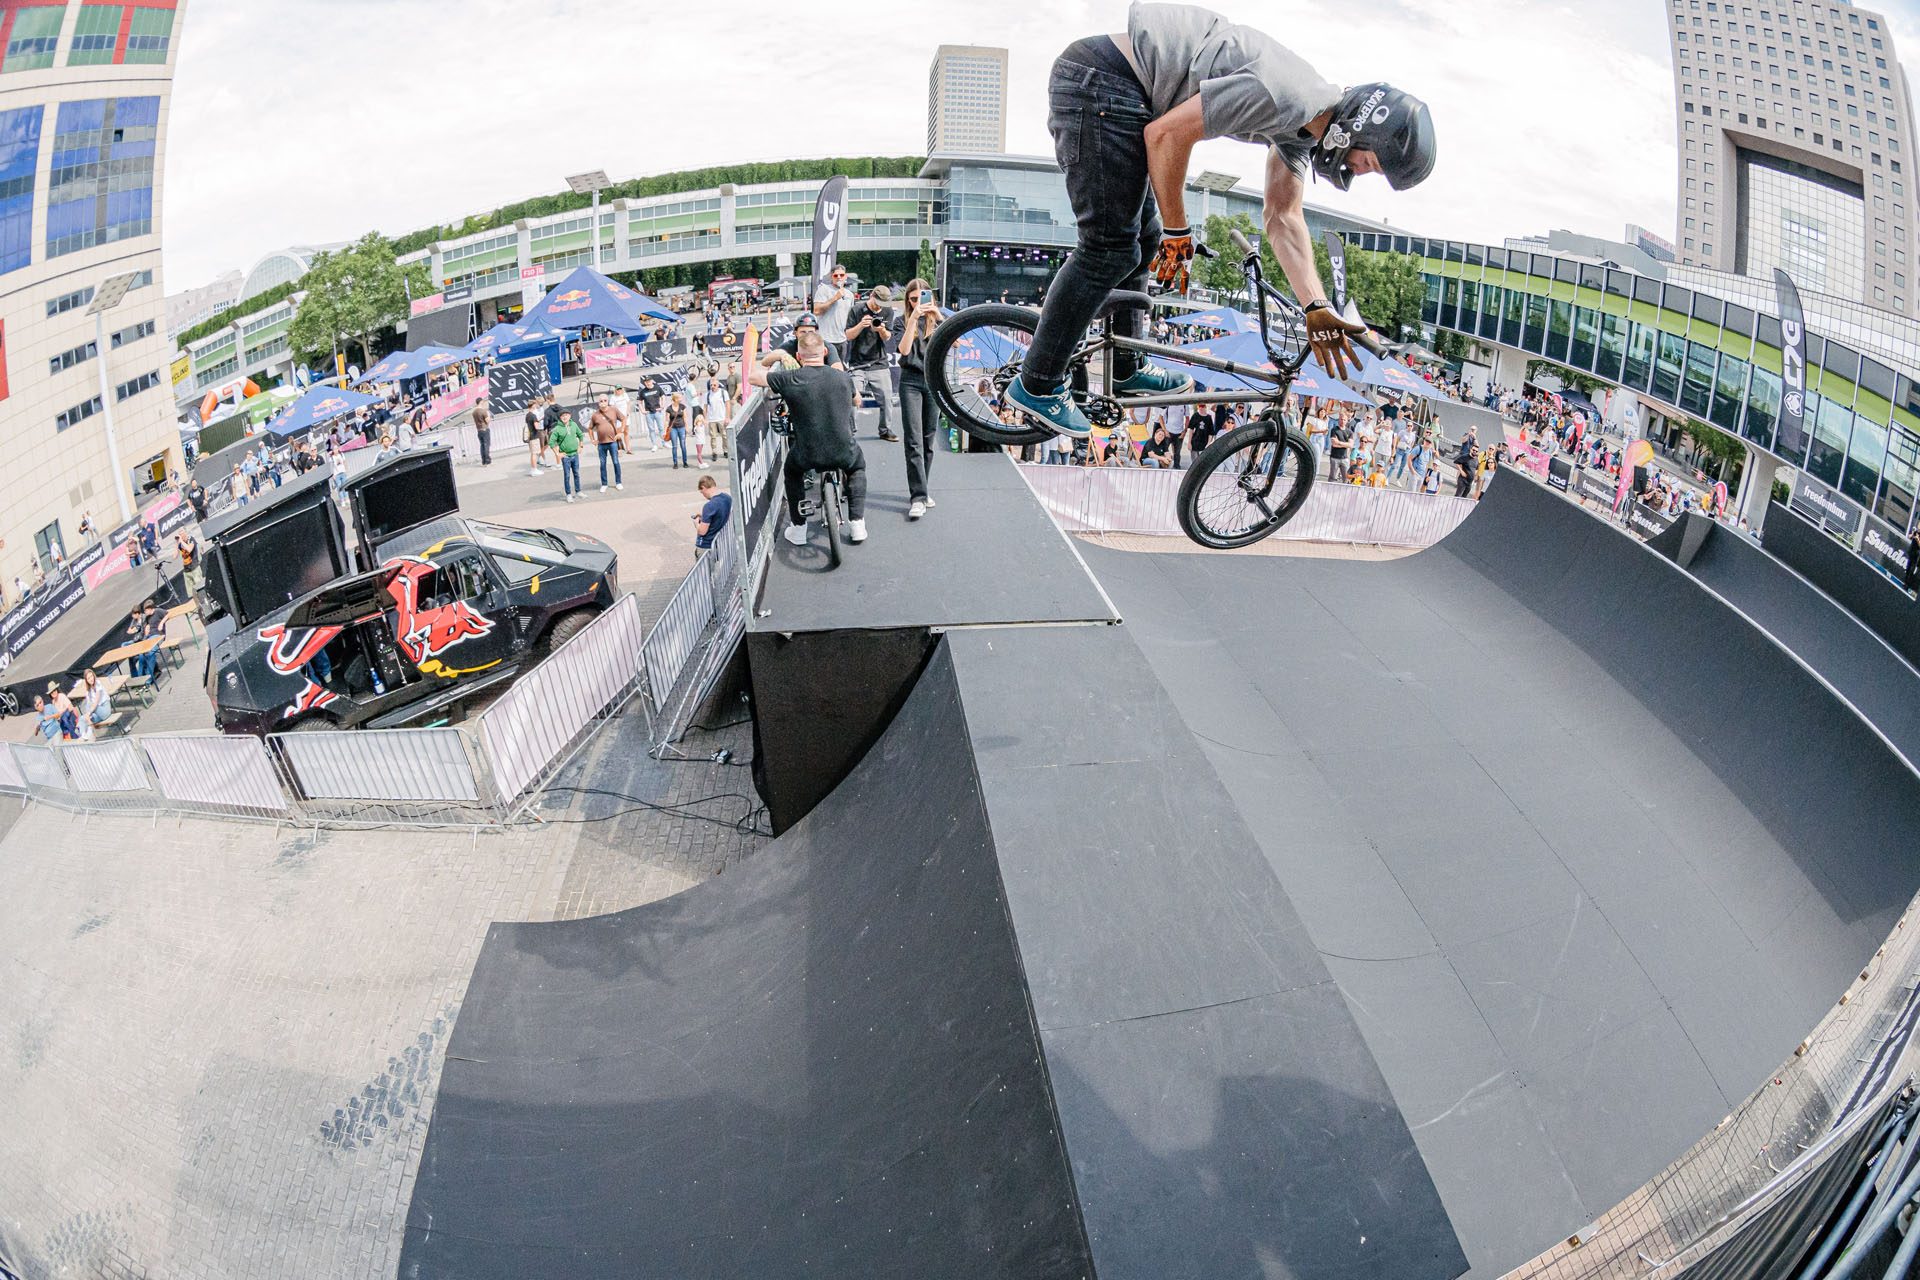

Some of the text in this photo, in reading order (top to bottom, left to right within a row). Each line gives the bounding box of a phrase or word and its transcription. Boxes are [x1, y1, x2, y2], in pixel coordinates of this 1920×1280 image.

[1353, 89, 1386, 131] SKATEPRO
[547, 298, 592, 314] Red Bull
[711, 344, 743, 352] RASOULUTIO
[1312, 329, 1340, 342] FIST
[958, 349, 981, 361] ull
[1803, 485, 1848, 521] freedombmx
[72, 547, 103, 575] AMFLOW
[1864, 529, 1909, 570] Sunda
[1, 600, 34, 636] AMFLOW
[10, 586, 84, 653] VERDE VERDE VERDE
